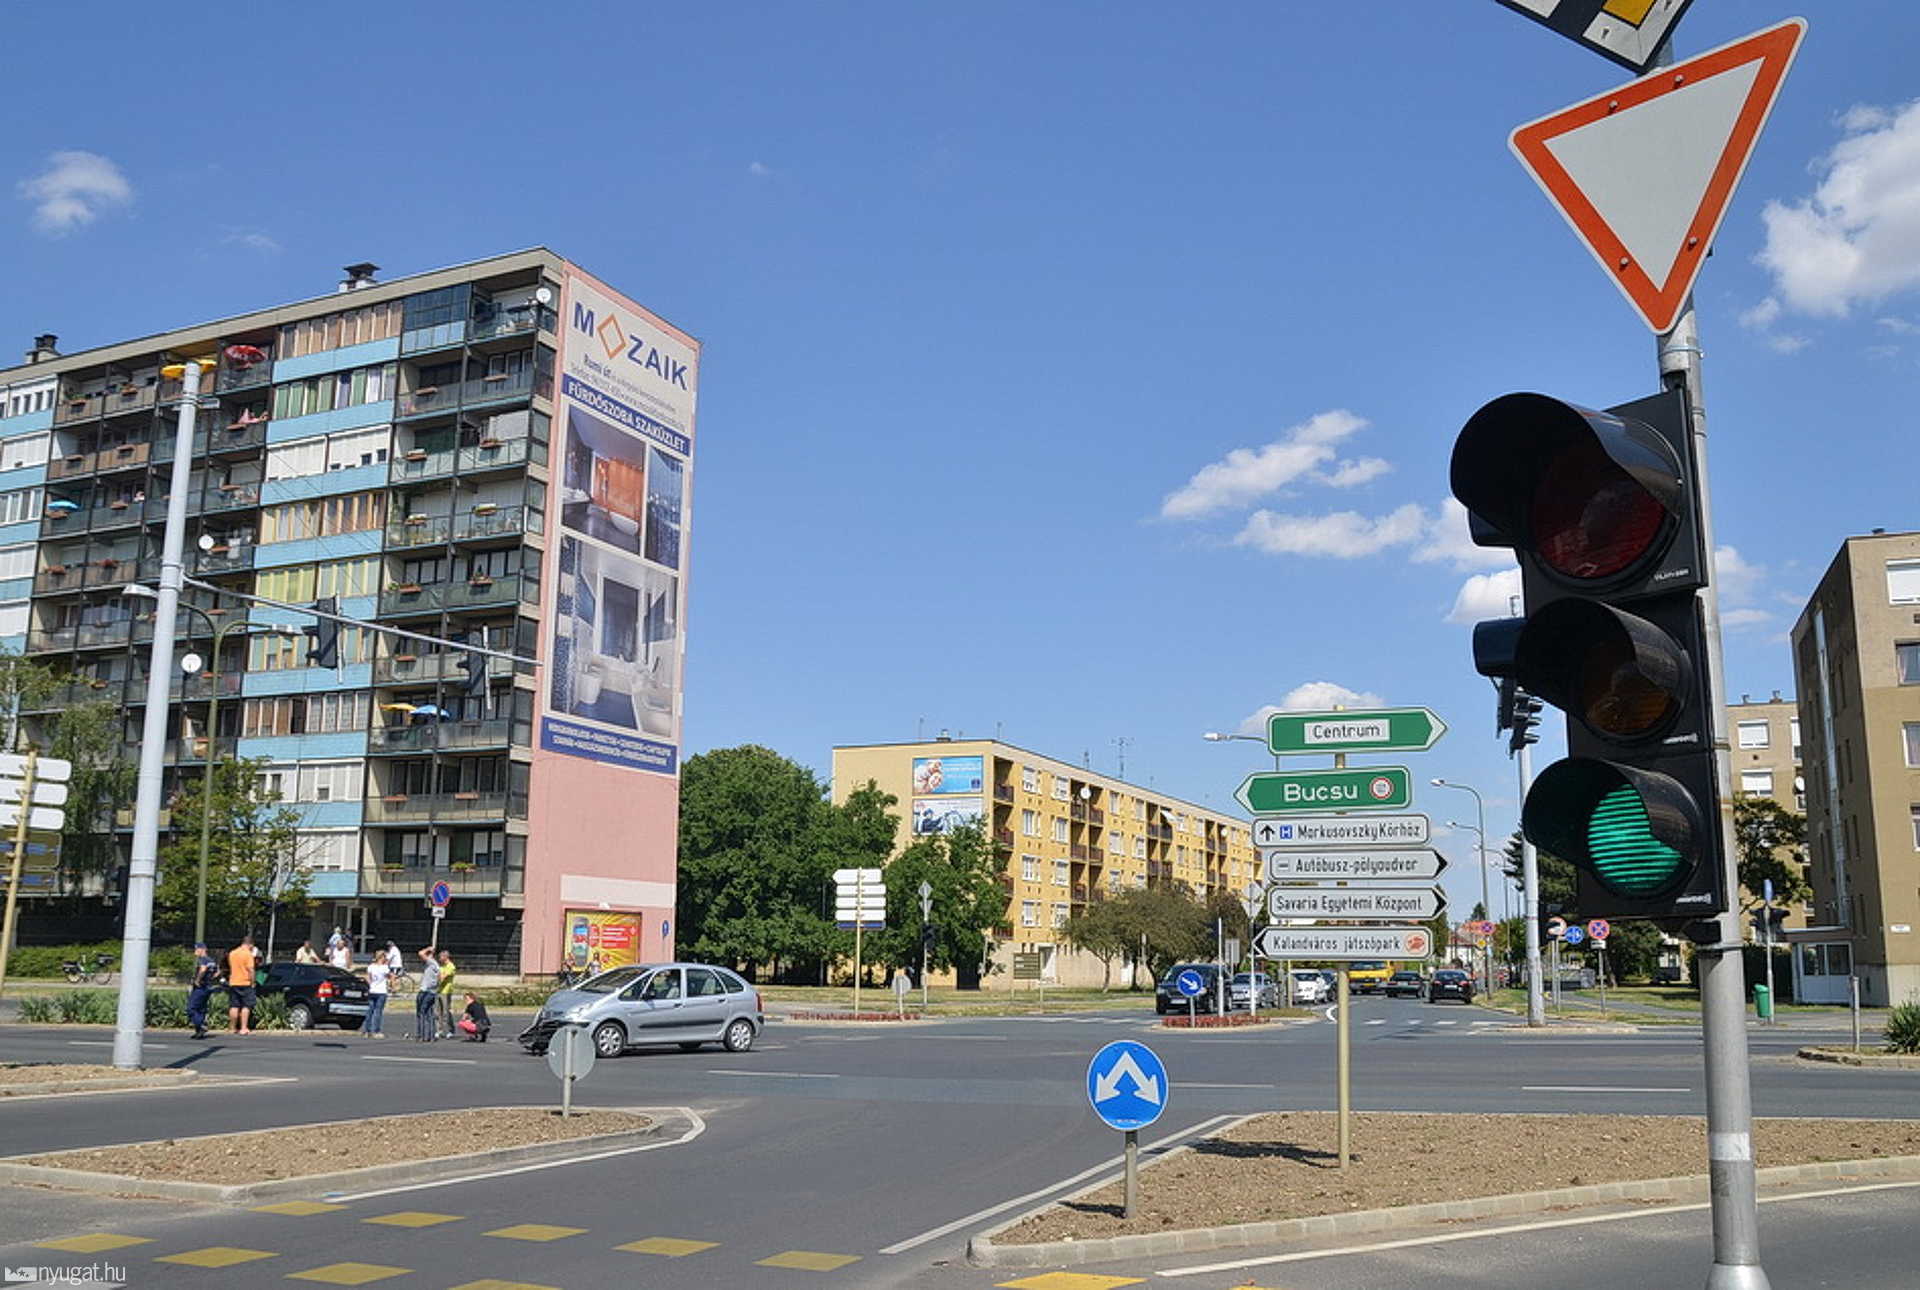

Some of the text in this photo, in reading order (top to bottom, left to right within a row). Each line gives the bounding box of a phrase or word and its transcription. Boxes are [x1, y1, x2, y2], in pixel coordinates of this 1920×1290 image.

[574, 302, 687, 390] MOZAIK
[1313, 725, 1381, 741] Centrum
[1284, 782, 1358, 802] Bucsu
[1296, 857, 1418, 876] Autóbusz-pályaudvar
[1277, 895, 1422, 912] Savaria Egyetemi Központ
[1273, 935, 1400, 953] Kalandváros játszópark
